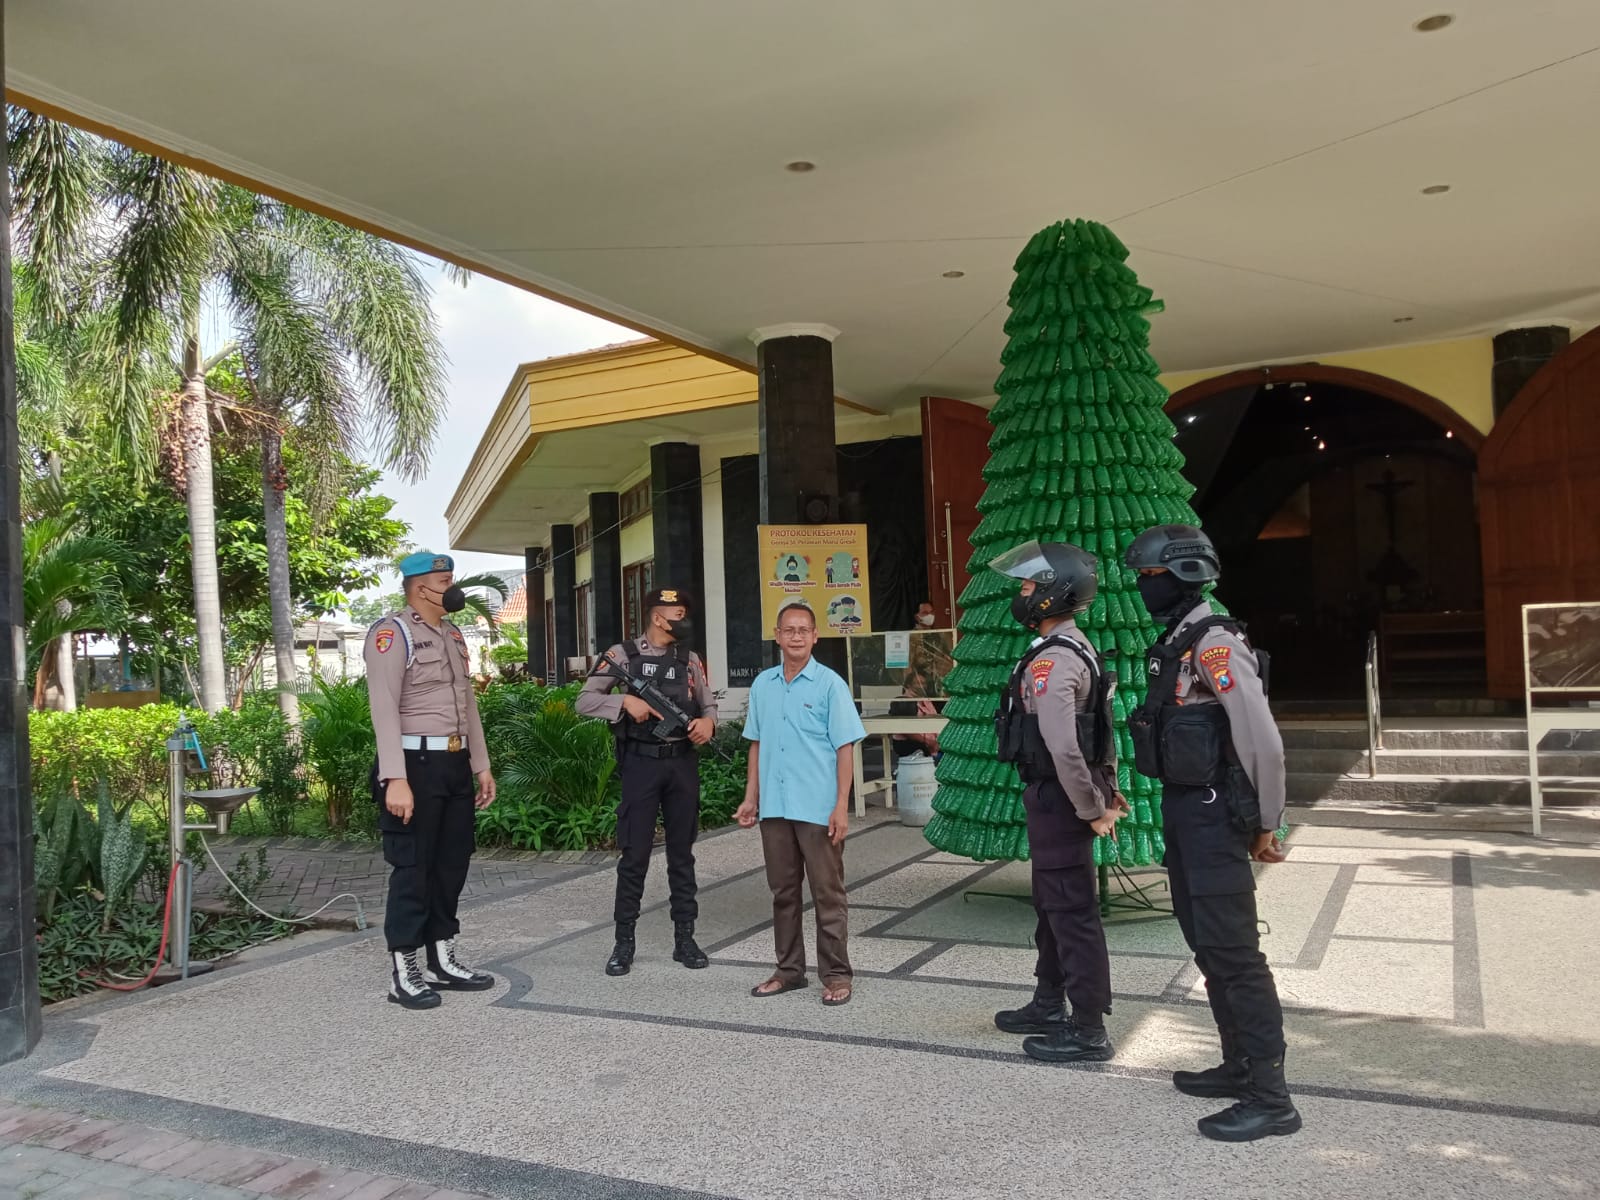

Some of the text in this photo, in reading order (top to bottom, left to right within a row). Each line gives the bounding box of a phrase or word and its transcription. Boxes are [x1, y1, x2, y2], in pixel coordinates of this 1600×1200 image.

[770, 529, 856, 537] PROTOKOL KESEHATAN
[730, 667, 750, 678] MARK
